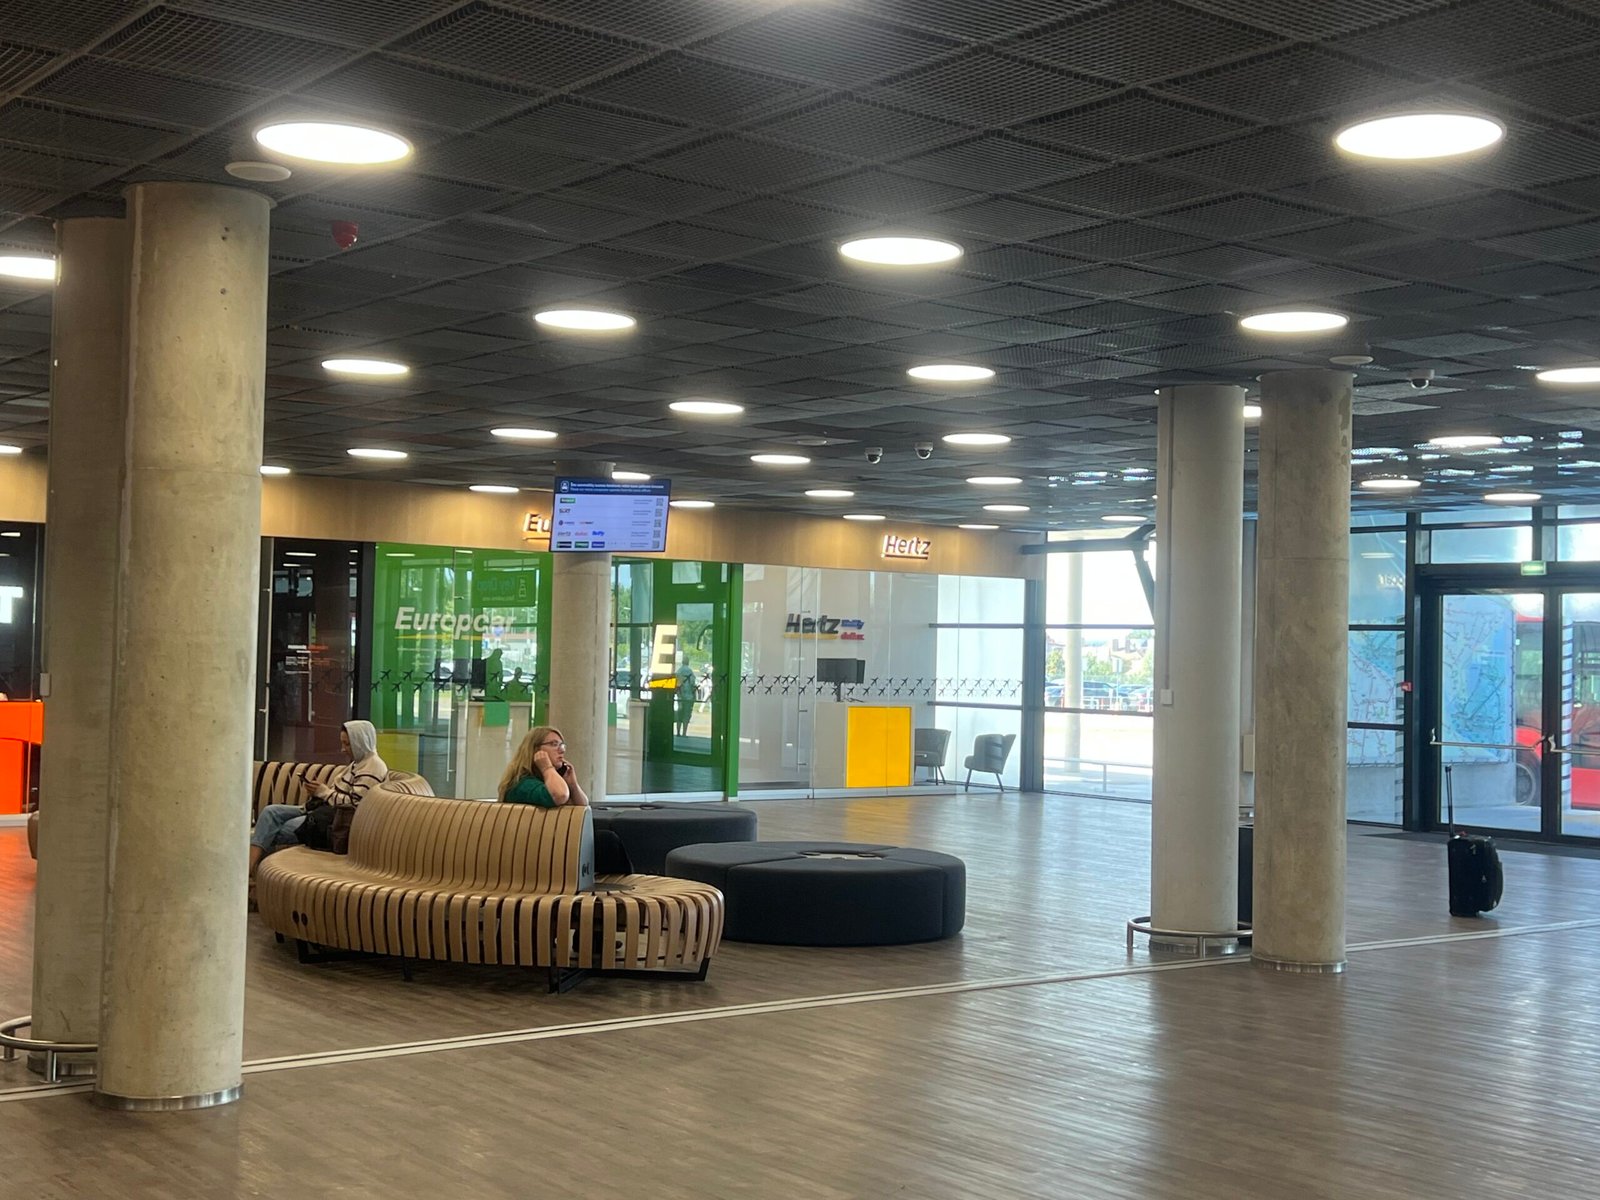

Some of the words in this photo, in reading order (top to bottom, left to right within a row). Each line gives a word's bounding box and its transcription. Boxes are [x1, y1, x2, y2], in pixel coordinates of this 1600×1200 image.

[882, 535, 931, 555] Hertz
[395, 606, 517, 640] Europcar
[785, 613, 841, 634] Hertz
